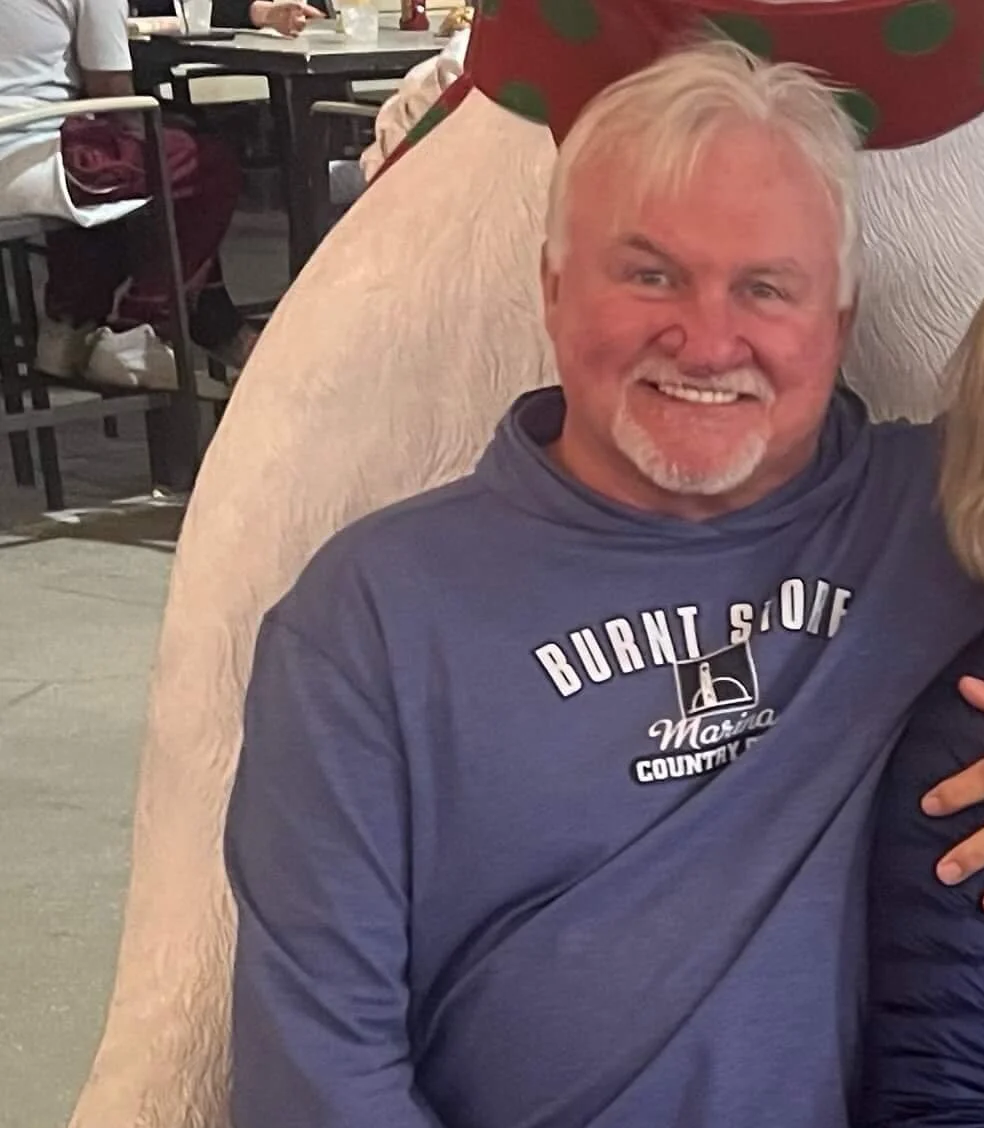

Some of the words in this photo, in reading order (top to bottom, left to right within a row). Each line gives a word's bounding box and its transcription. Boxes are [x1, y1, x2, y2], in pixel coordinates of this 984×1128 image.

[535, 605, 701, 697] BURNT
[648, 708, 776, 751] Marina
[636, 742, 740, 783] COUNTRY
